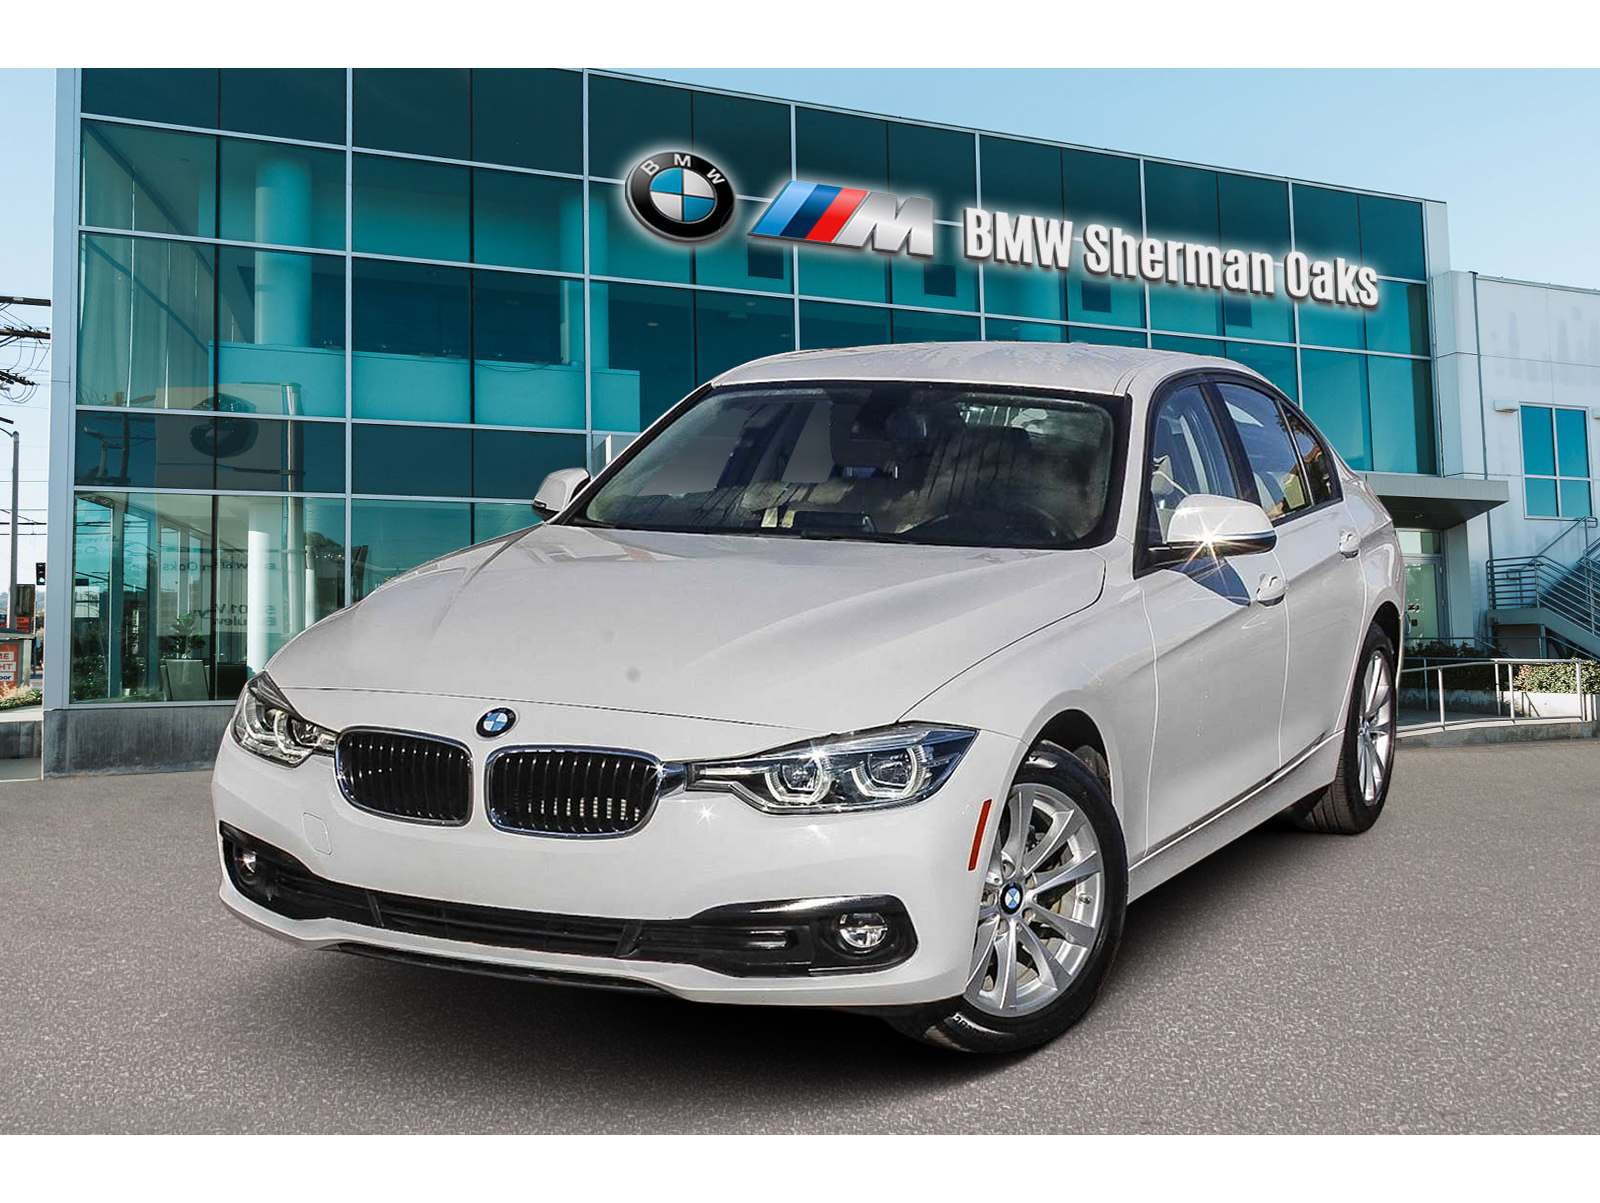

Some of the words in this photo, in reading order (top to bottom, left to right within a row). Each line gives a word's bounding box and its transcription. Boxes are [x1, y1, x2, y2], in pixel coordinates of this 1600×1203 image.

[640, 153, 726, 186] BMW
[963, 207, 1074, 270] BMW
[1082, 223, 1276, 297] Sherman
[1284, 251, 1380, 308] Oaks
